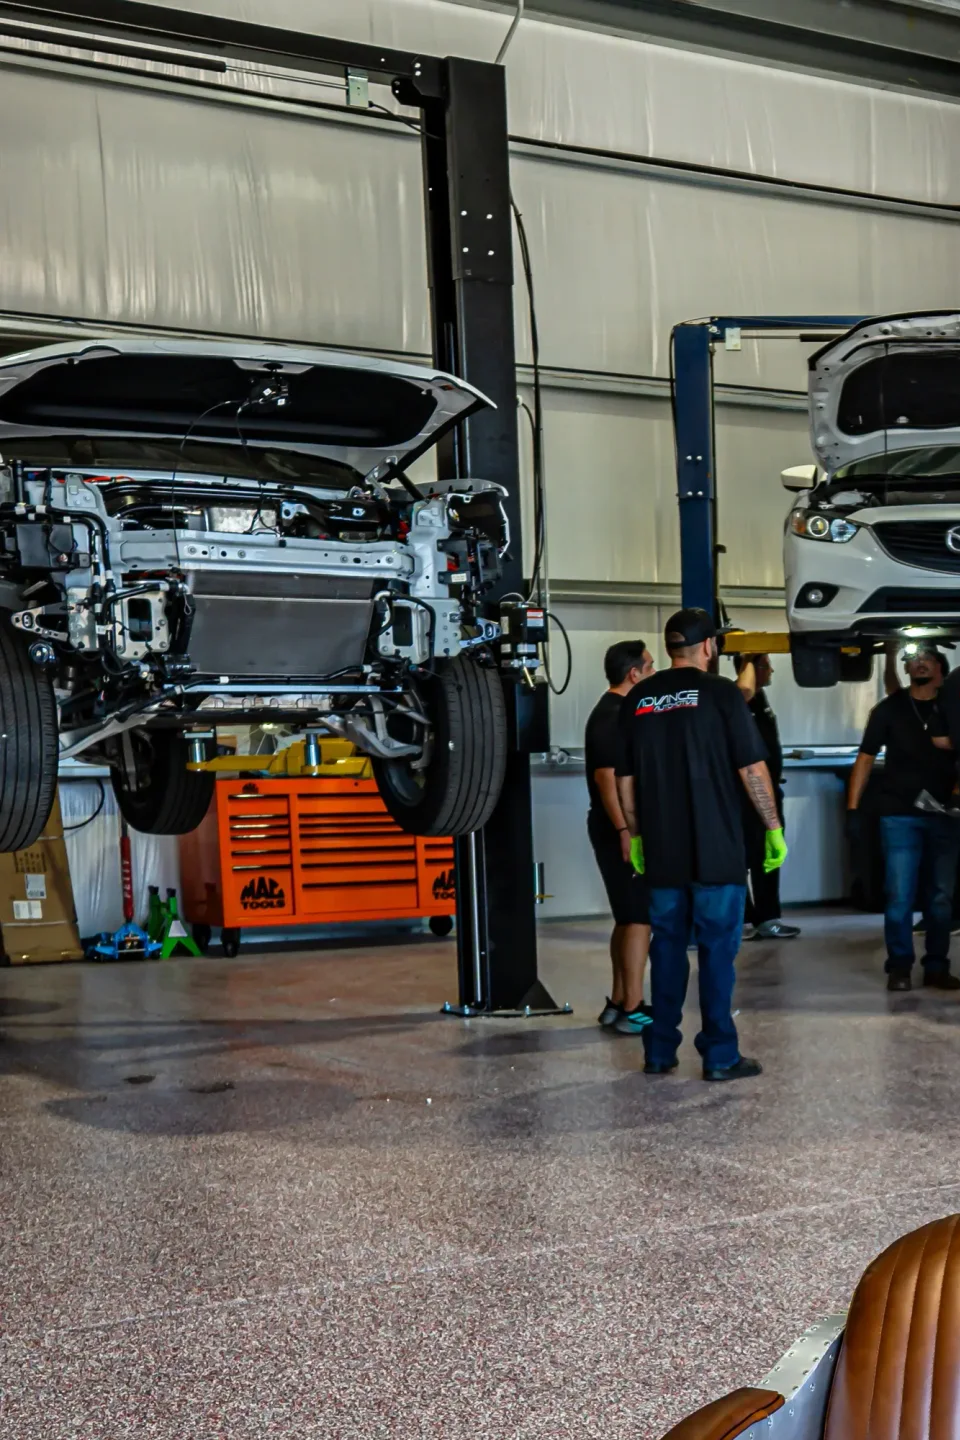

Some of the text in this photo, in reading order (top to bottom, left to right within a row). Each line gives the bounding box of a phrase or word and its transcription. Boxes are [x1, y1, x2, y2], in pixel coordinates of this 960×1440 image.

[636, 689, 699, 710] ADVANCE
[240, 876, 285, 900] MAC
[241, 899, 286, 910] TOOLS
